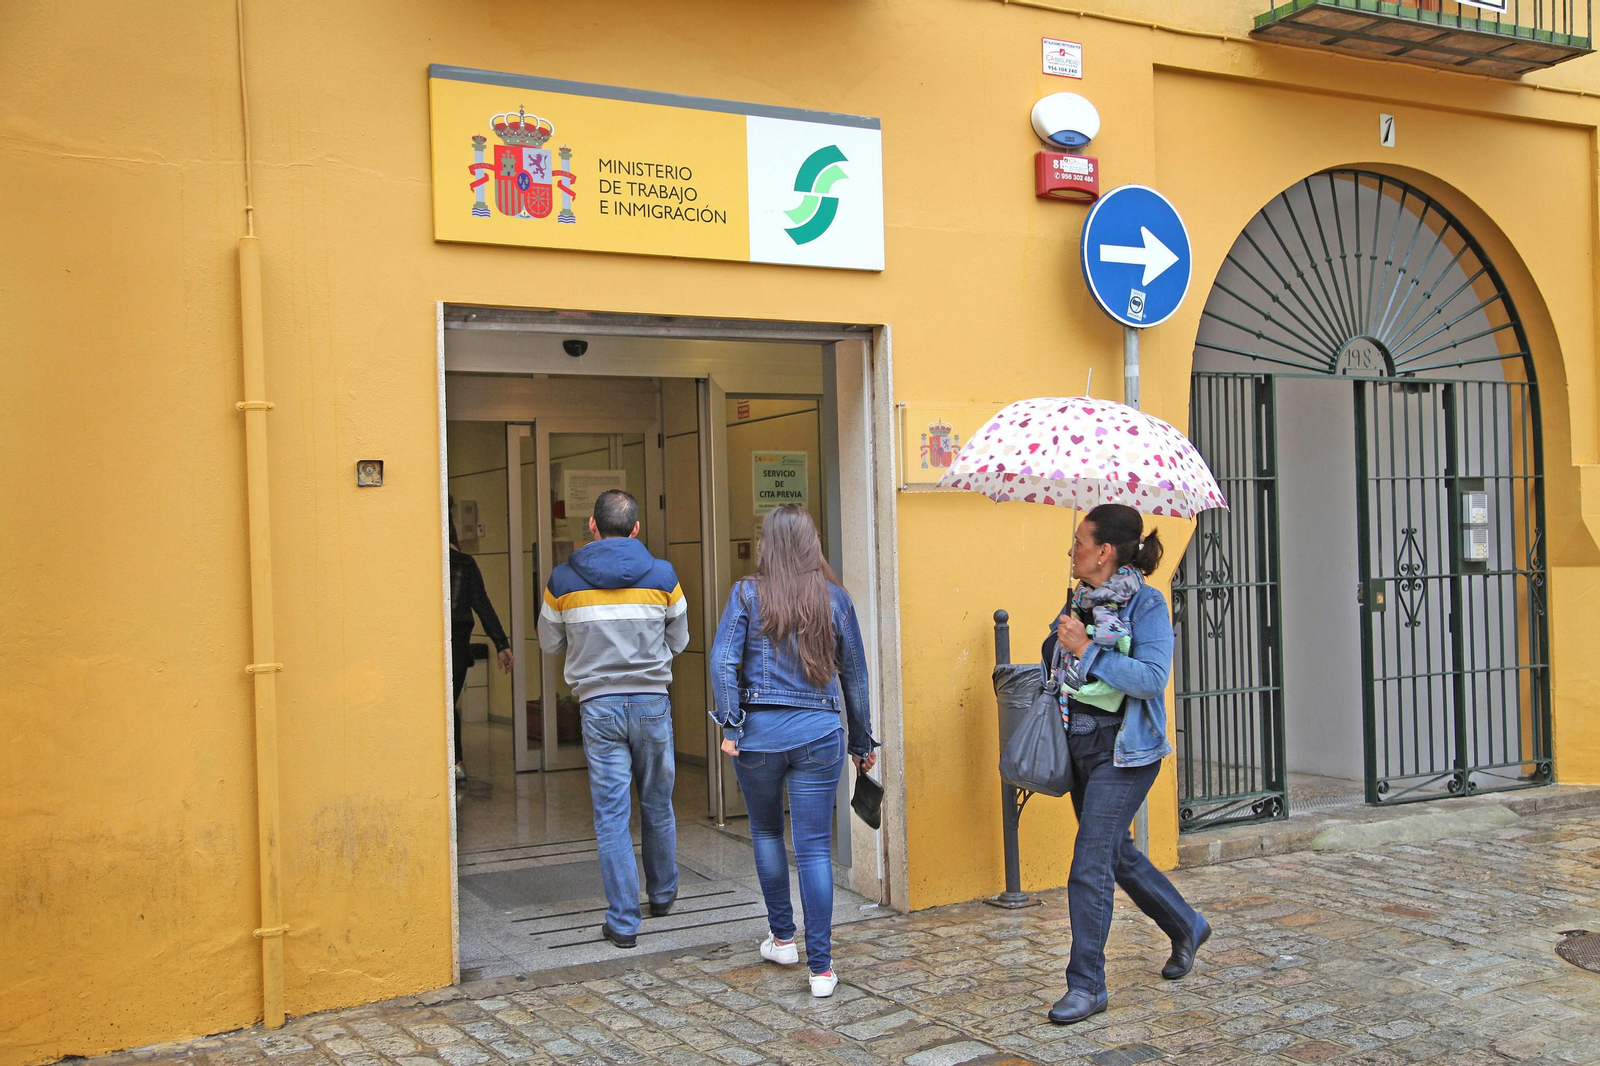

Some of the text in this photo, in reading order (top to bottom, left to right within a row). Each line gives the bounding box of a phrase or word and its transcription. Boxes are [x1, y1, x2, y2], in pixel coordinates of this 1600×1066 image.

[599, 158, 692, 181] MINISTERIO
[599, 179, 697, 204] DE TRABAJO
[600, 200, 726, 224] E INMIGRACIÓN
